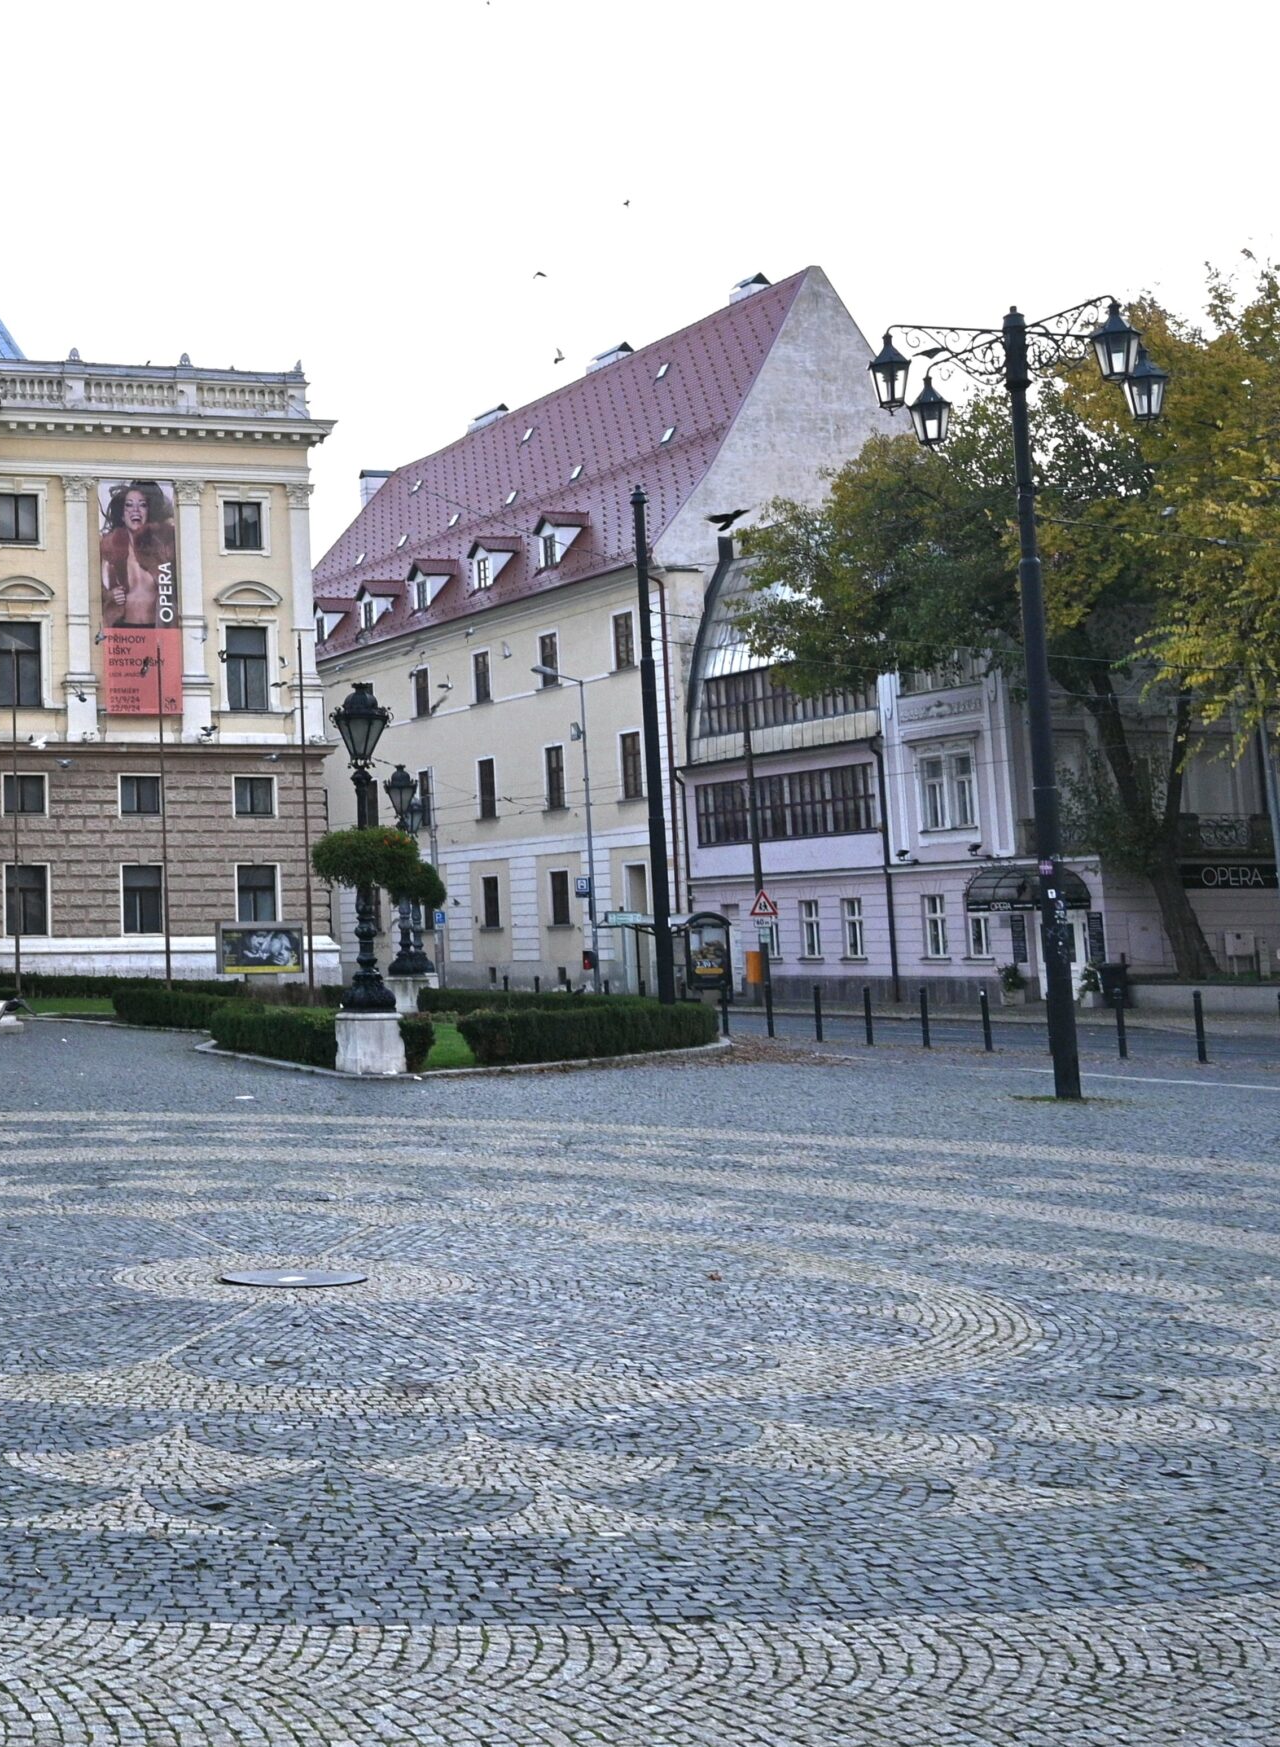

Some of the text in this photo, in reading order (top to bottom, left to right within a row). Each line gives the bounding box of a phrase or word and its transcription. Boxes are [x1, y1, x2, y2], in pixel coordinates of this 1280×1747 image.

[158, 562, 174, 623] OPERA
[1201, 867, 1265, 886] OPERA
[989, 902, 1012, 911] OPERA
